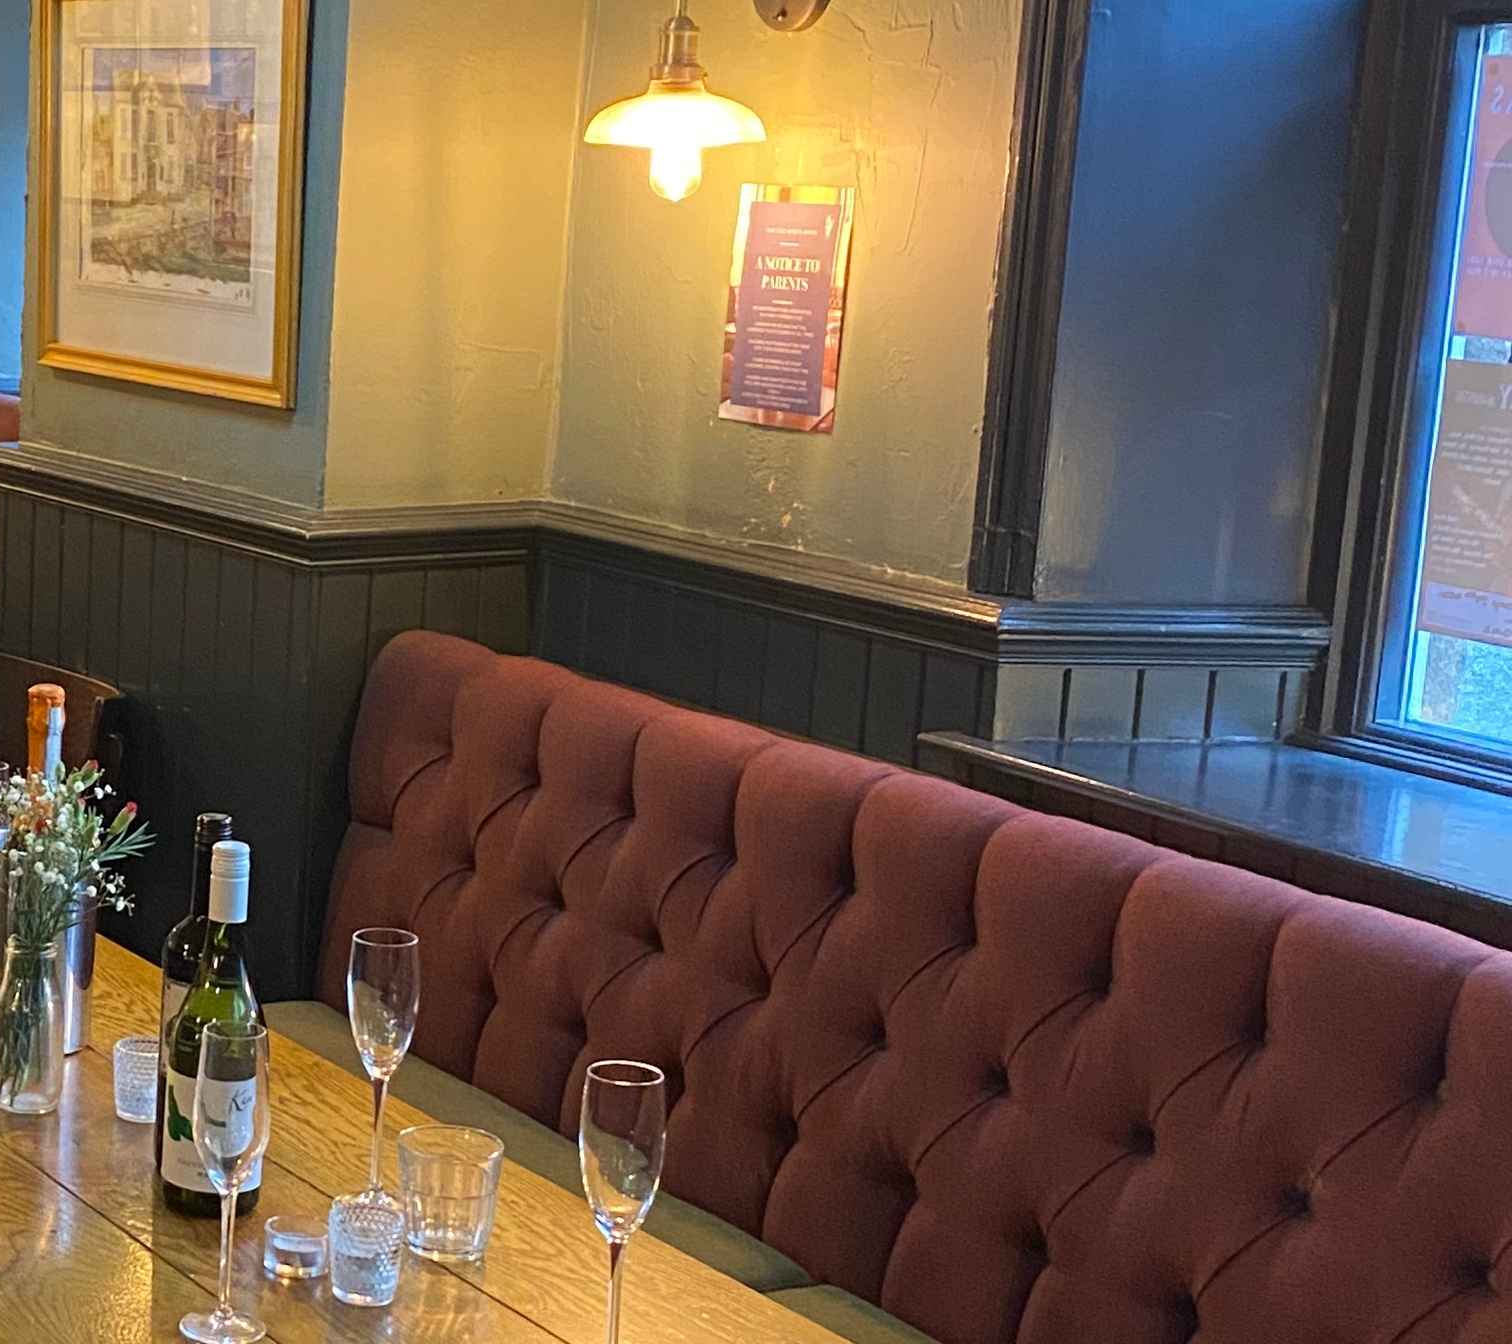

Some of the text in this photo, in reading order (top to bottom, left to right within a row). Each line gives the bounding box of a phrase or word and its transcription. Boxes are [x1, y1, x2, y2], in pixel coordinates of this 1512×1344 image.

[755, 256, 821, 273] A NOTICE TO
[761, 274, 809, 292] PARENTS
